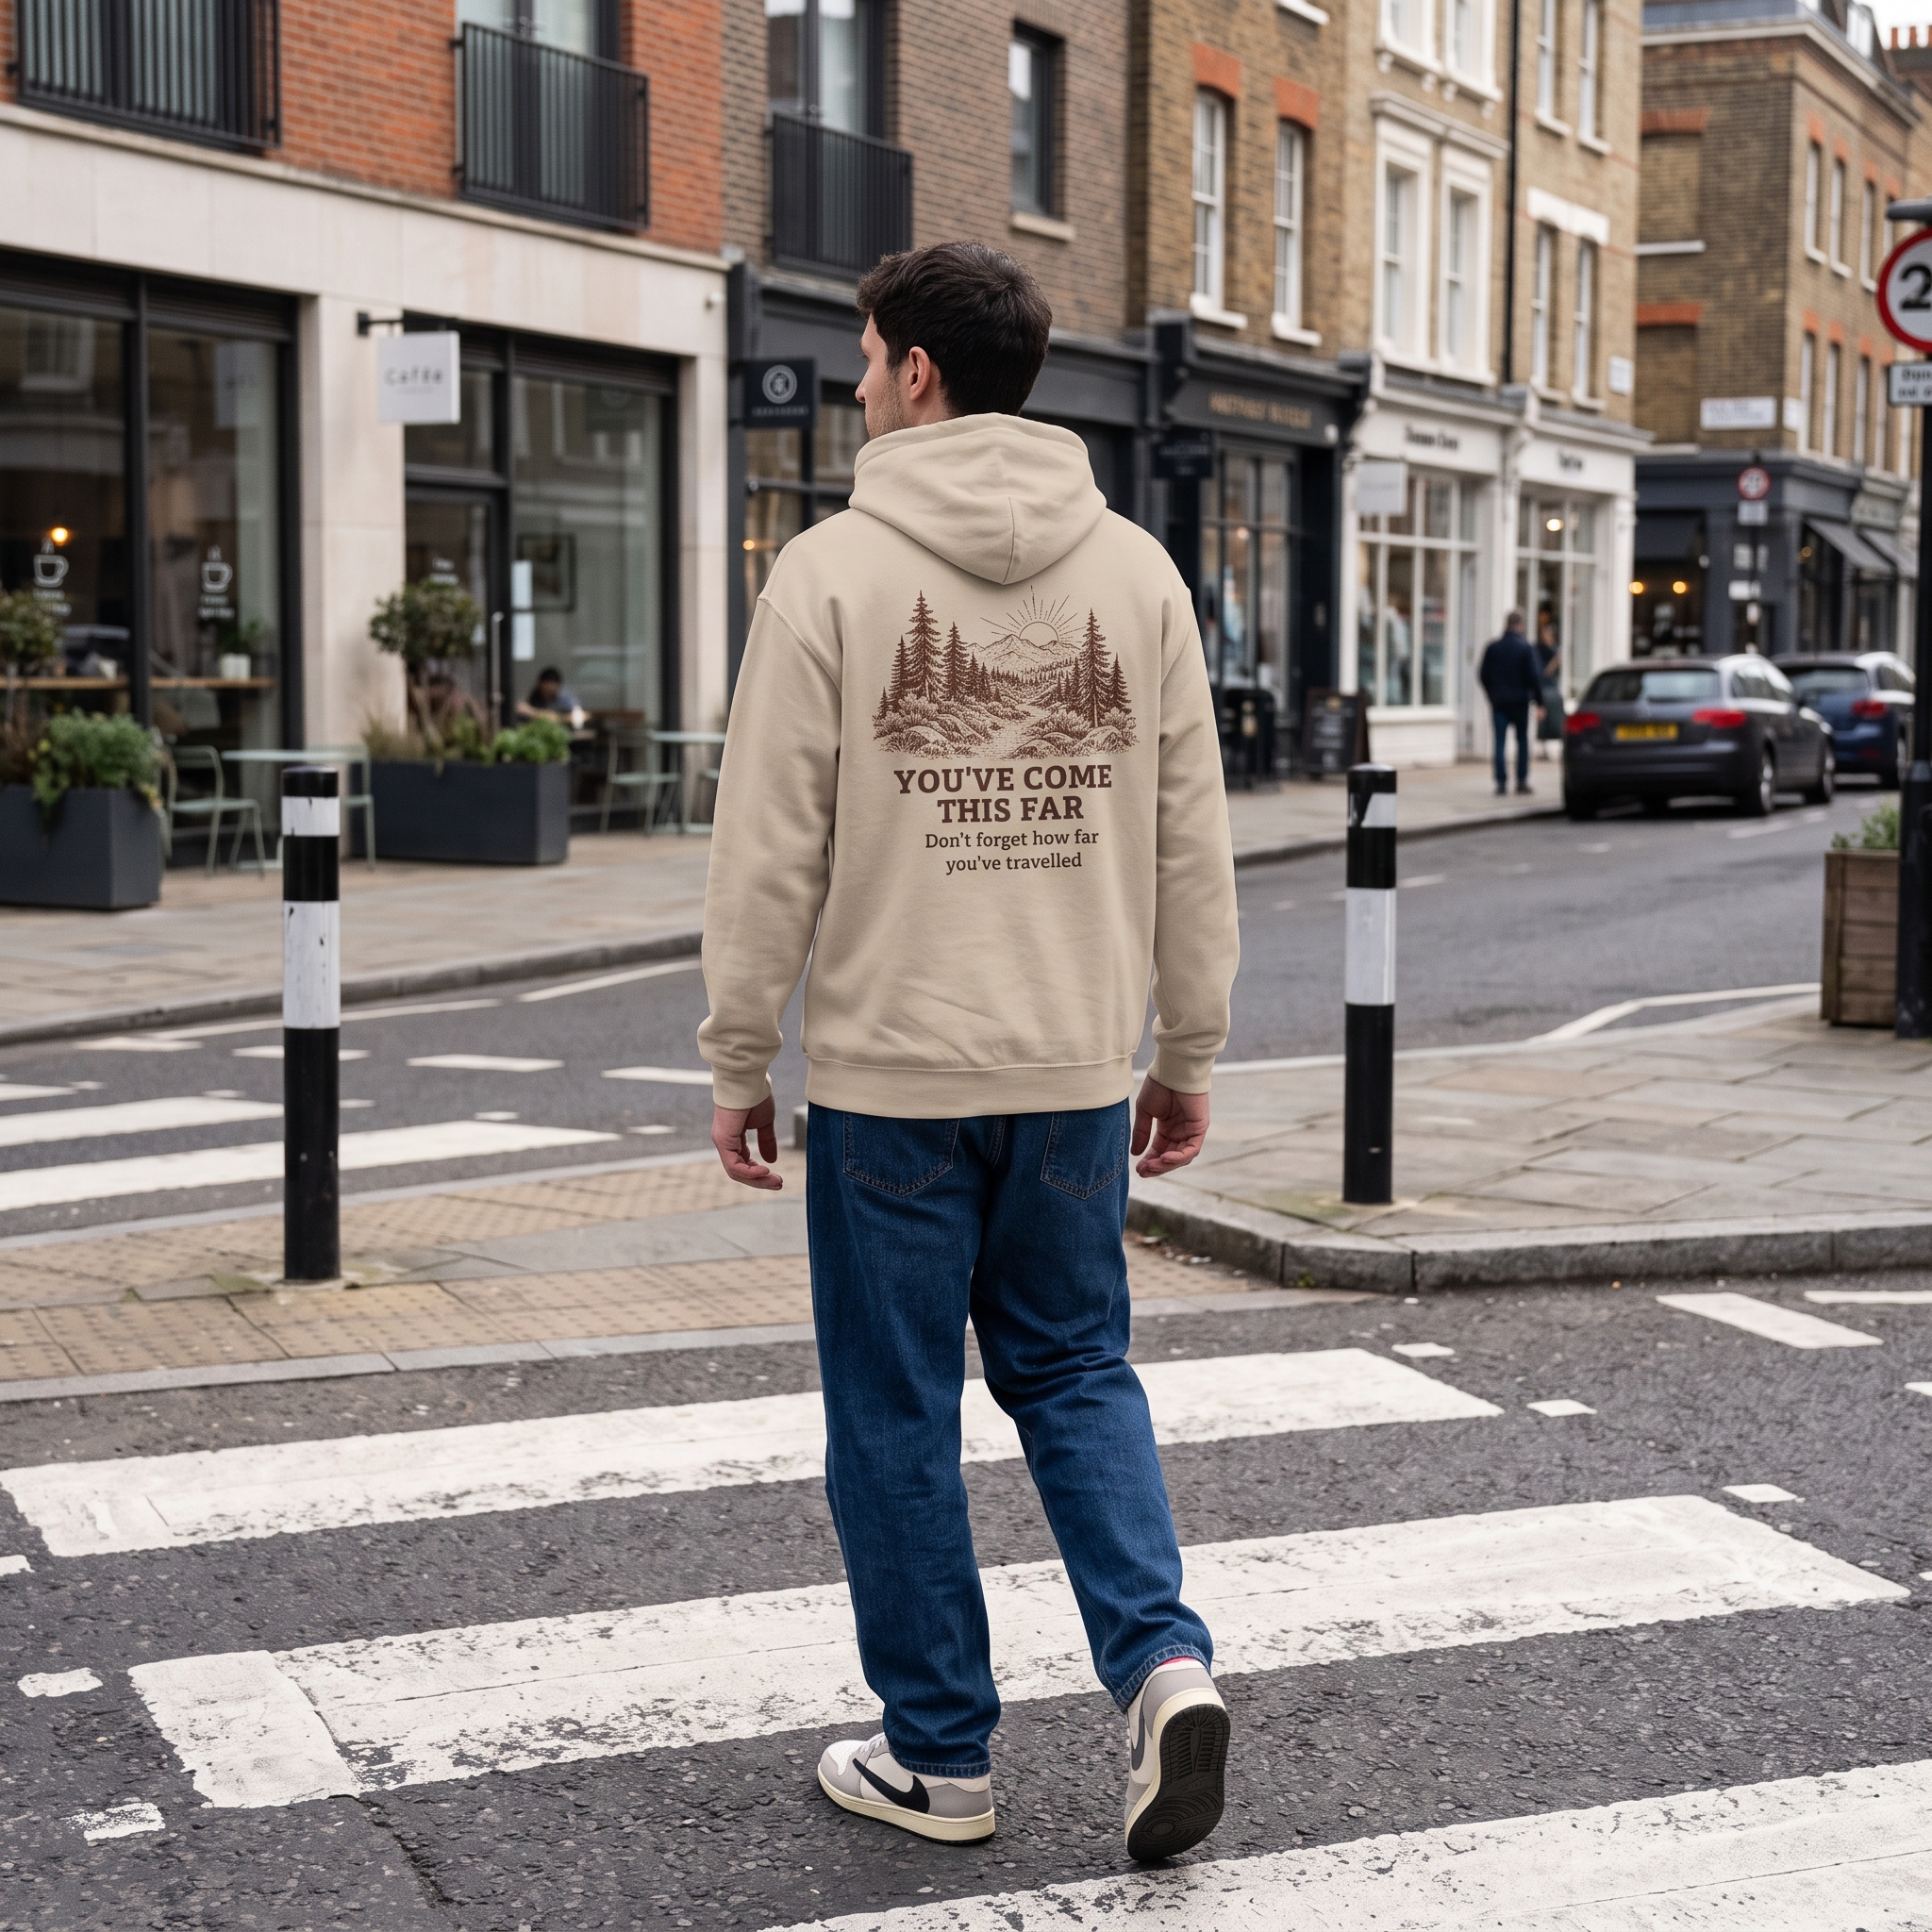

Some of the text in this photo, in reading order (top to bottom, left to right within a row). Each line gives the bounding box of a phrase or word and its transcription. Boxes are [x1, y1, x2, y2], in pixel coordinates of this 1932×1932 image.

[894, 764, 1112, 794] YOU'VE COME
[937, 795, 1085, 824] THIS FAR
[925, 828, 1099, 851] Don't forget how far
[945, 852, 1083, 875] you've travelled
